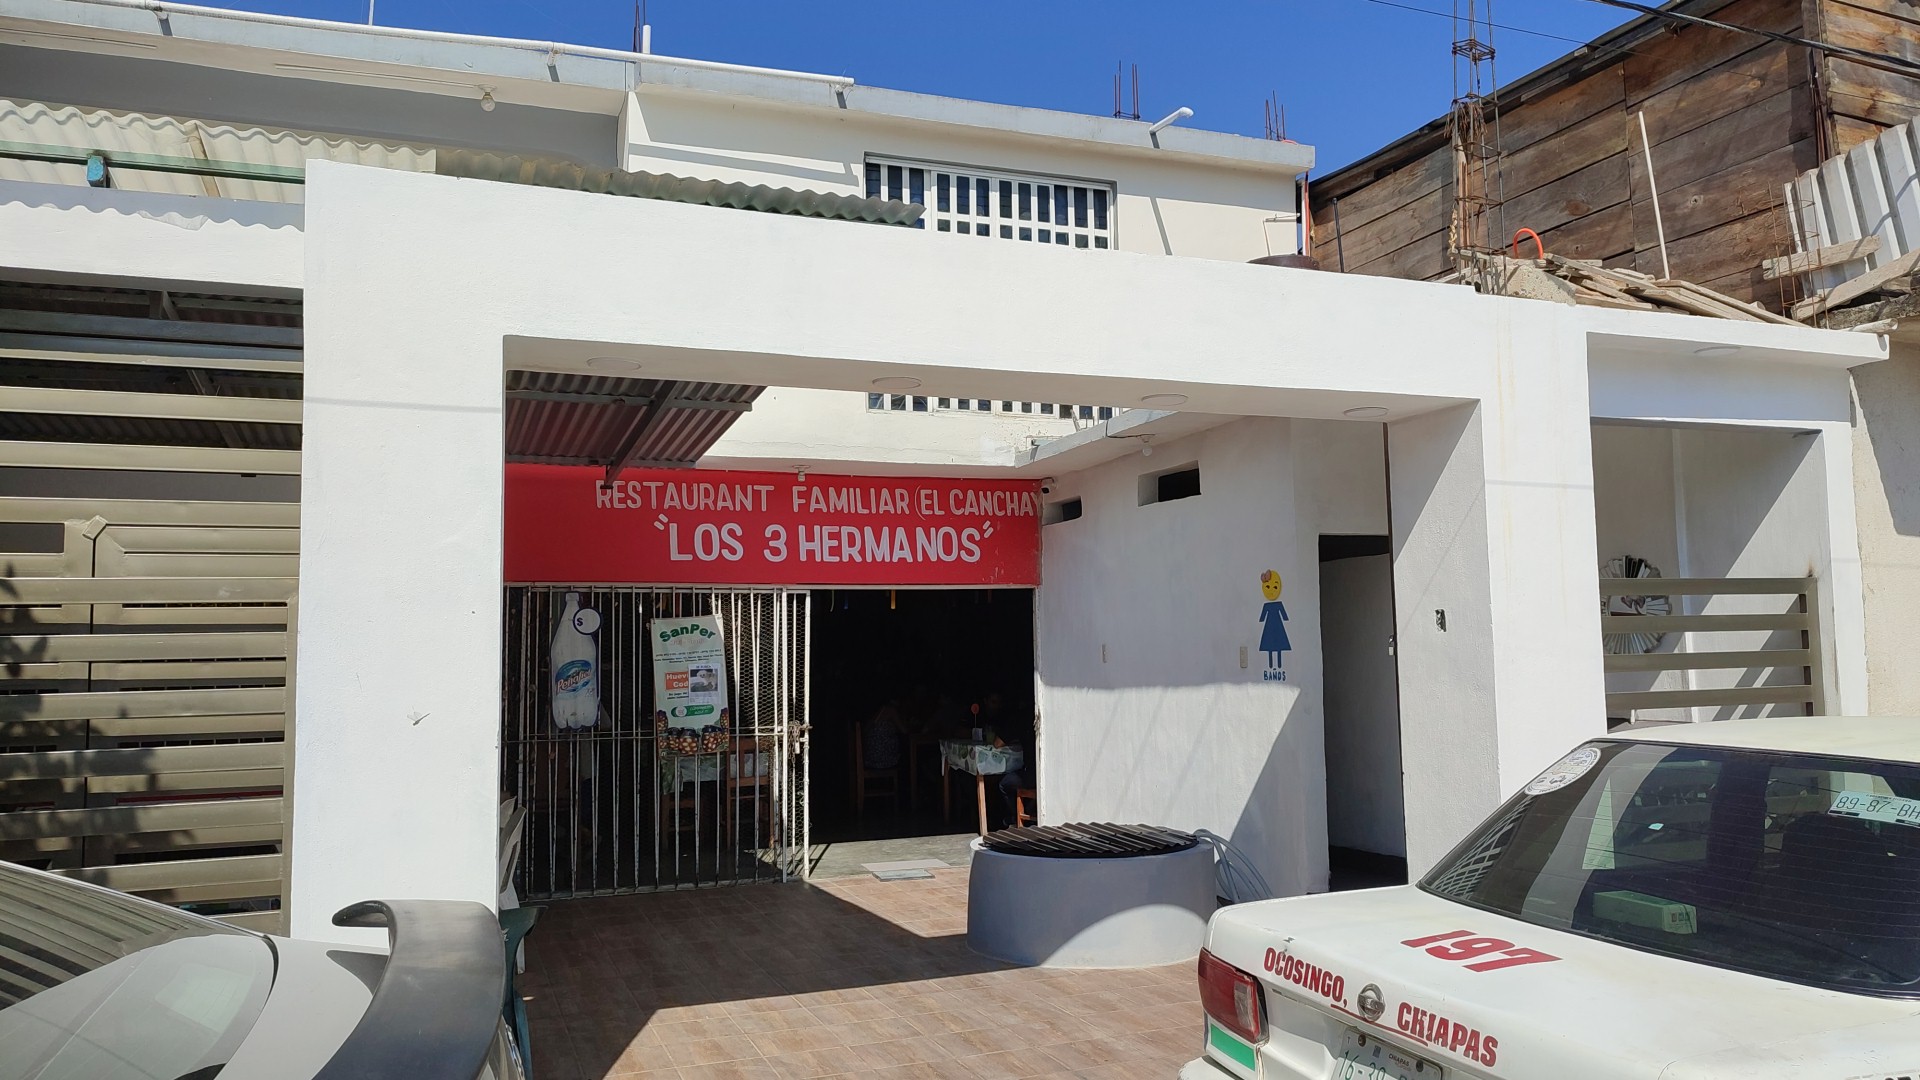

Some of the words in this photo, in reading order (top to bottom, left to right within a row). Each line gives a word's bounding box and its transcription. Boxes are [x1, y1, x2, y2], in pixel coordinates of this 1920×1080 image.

[595, 480, 775, 512] RESTAURANT
[791, 485, 910, 514] FAMILIAR
[763, 523, 788, 563] 3
[659, 623, 716, 643] SanPer
[1263, 668, 1287, 681] BAÑOS
[1400, 929, 1563, 973] 197
[1263, 947, 1348, 1007] OCOSINGO,
[1397, 1002, 1499, 1067] CHIAPAS
[1388, 1053, 1410, 1067] CHIAPAS
